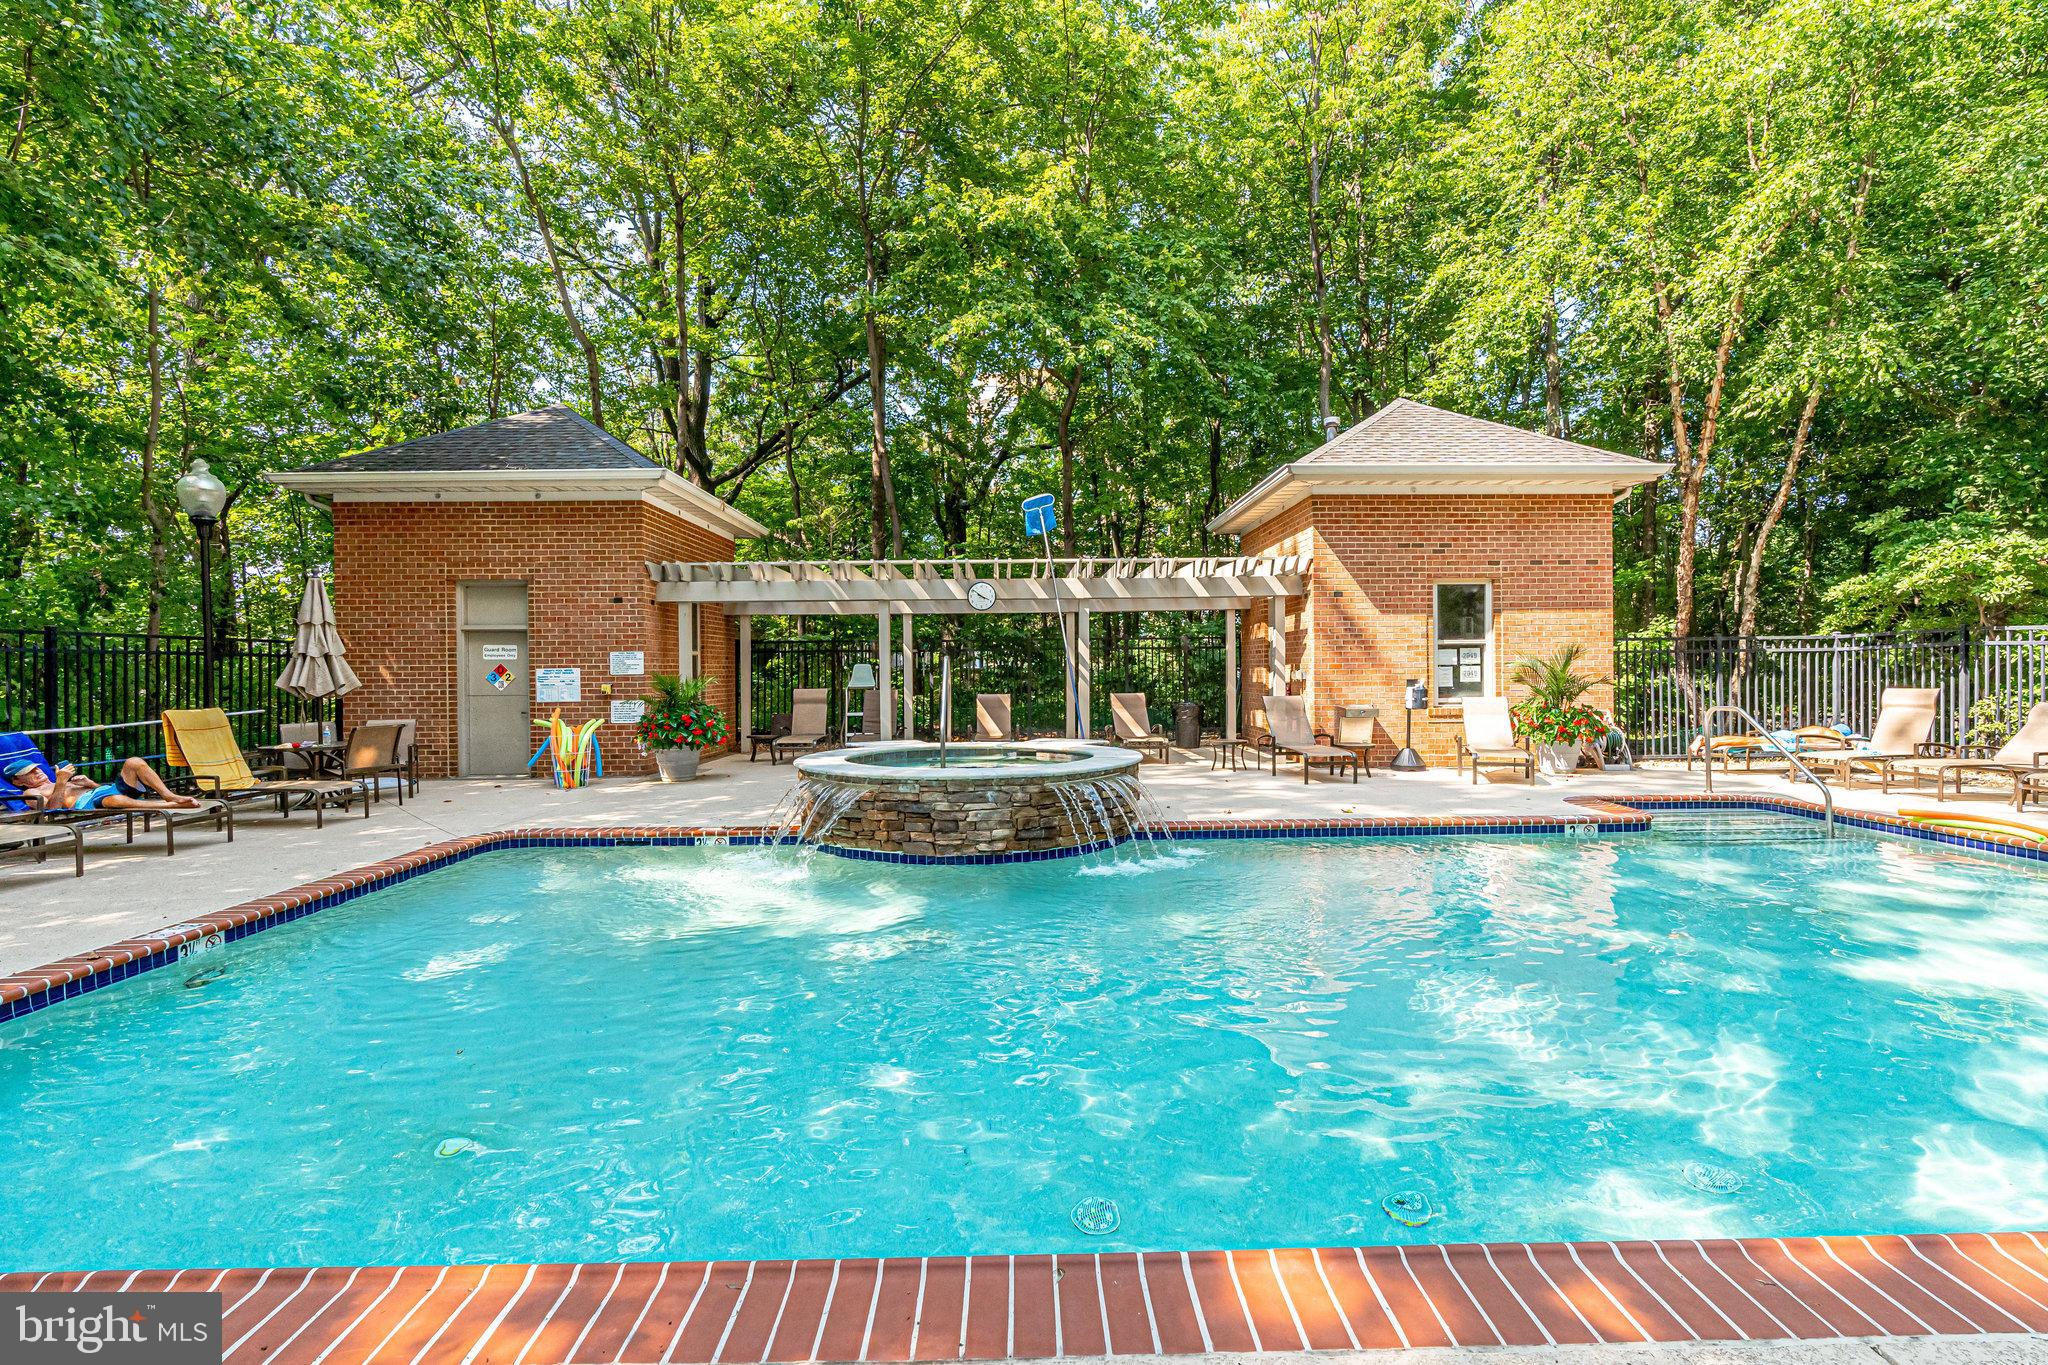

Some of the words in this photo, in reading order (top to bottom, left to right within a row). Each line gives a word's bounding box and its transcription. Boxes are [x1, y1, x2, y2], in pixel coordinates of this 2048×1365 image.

[497, 666, 504, 675] 0
[490, 672, 497, 682] 3
[505, 672, 512, 682] 2
